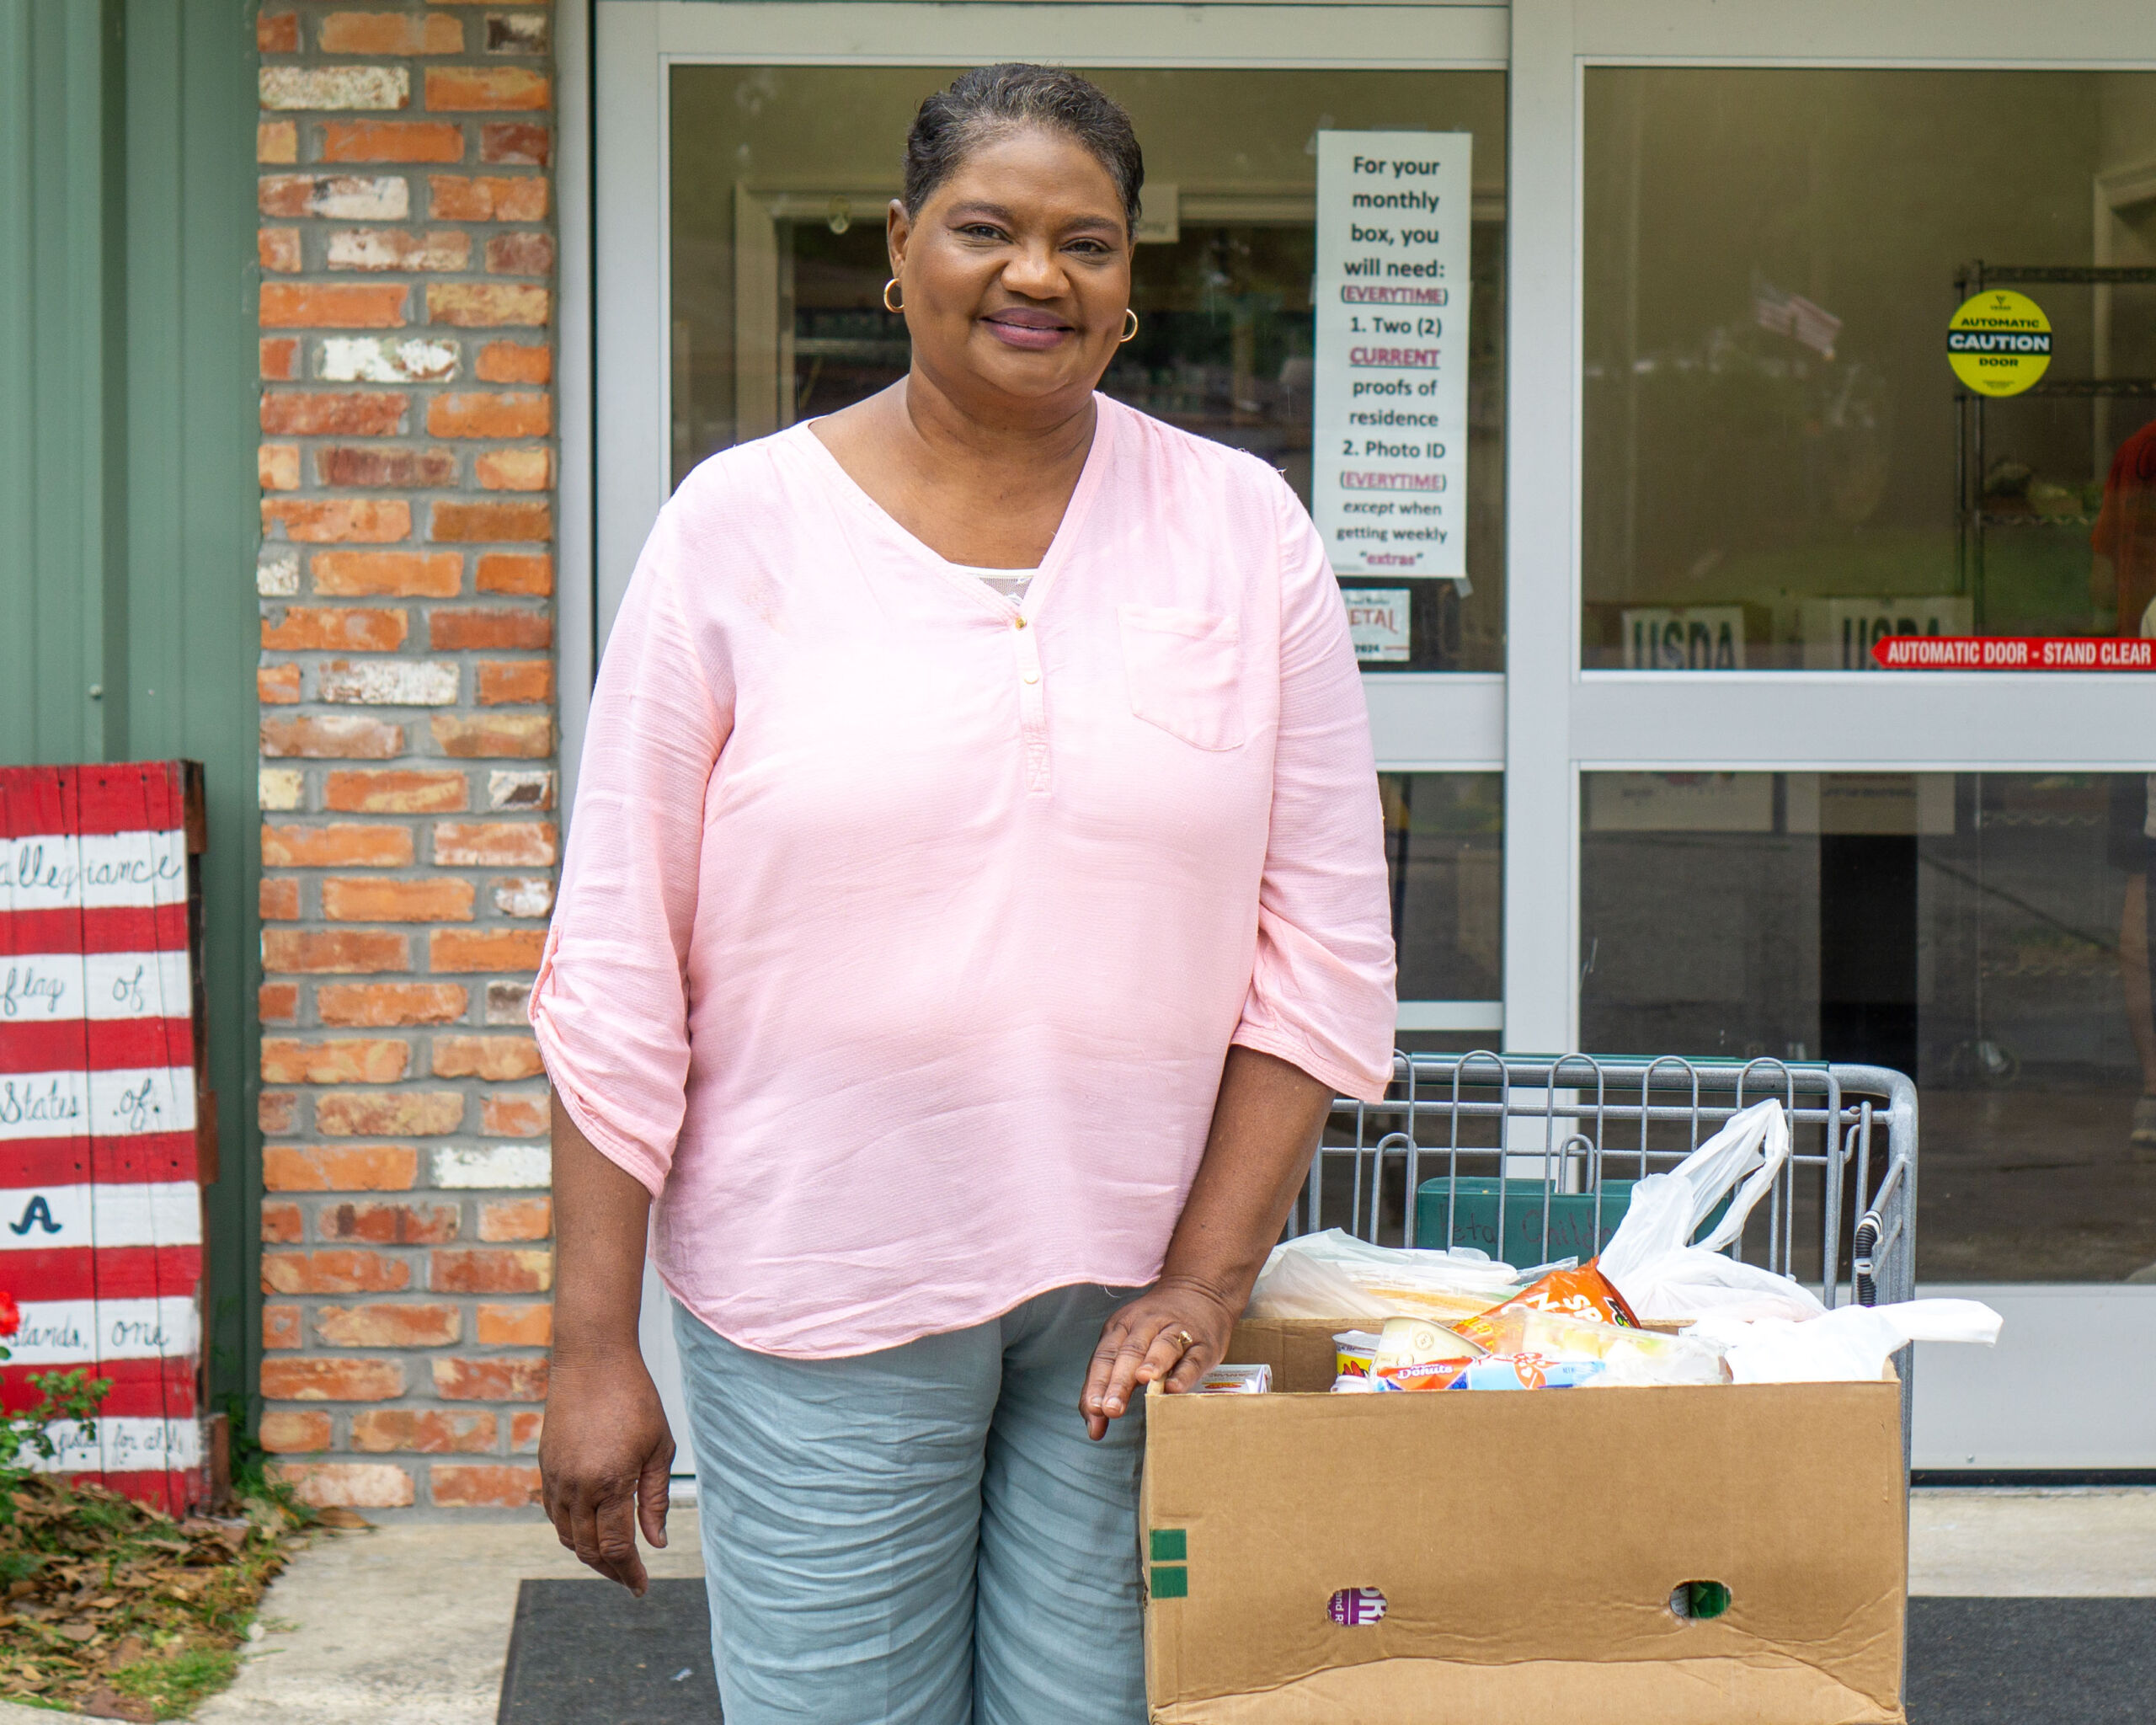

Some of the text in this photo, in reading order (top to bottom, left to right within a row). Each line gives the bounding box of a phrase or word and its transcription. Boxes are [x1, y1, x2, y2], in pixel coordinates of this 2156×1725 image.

[1353, 157, 1439, 179] For your
[1353, 191, 1439, 213] monthly
[1351, 224, 1438, 246] box, you
[1344, 259, 1445, 278] will need:
[1341, 285, 1448, 306] (EVERYTIME)
[1351, 317, 1442, 338] 1. Two (2)
[1961, 318, 2039, 328] AUTOMATIC
[1950, 334, 2049, 350] CAUTION
[1350, 347, 1441, 368] CURRENT
[1979, 358, 2019, 366] DOOR
[1353, 380, 1437, 397] proofs of
[1349, 411, 1438, 427] residence
[1342, 441, 1445, 458] 2. Photo ID
[1340, 471, 1447, 492] (EVERYTIME)
[1344, 502, 1442, 516] except when
[1337, 527, 1447, 543] getting weekly
[1349, 608, 1398, 634] ETAL
[1887, 641, 1980, 664] AUTOMATIC
[1984, 642, 2027, 664] DOOR
[2043, 643, 2096, 664] STAND
[2100, 643, 2151, 665] CLEAR
[0, 964, 144, 1016] flag of
[9, 1195, 62, 1234] A
[1397, 1365, 1454, 1380] Donuts
